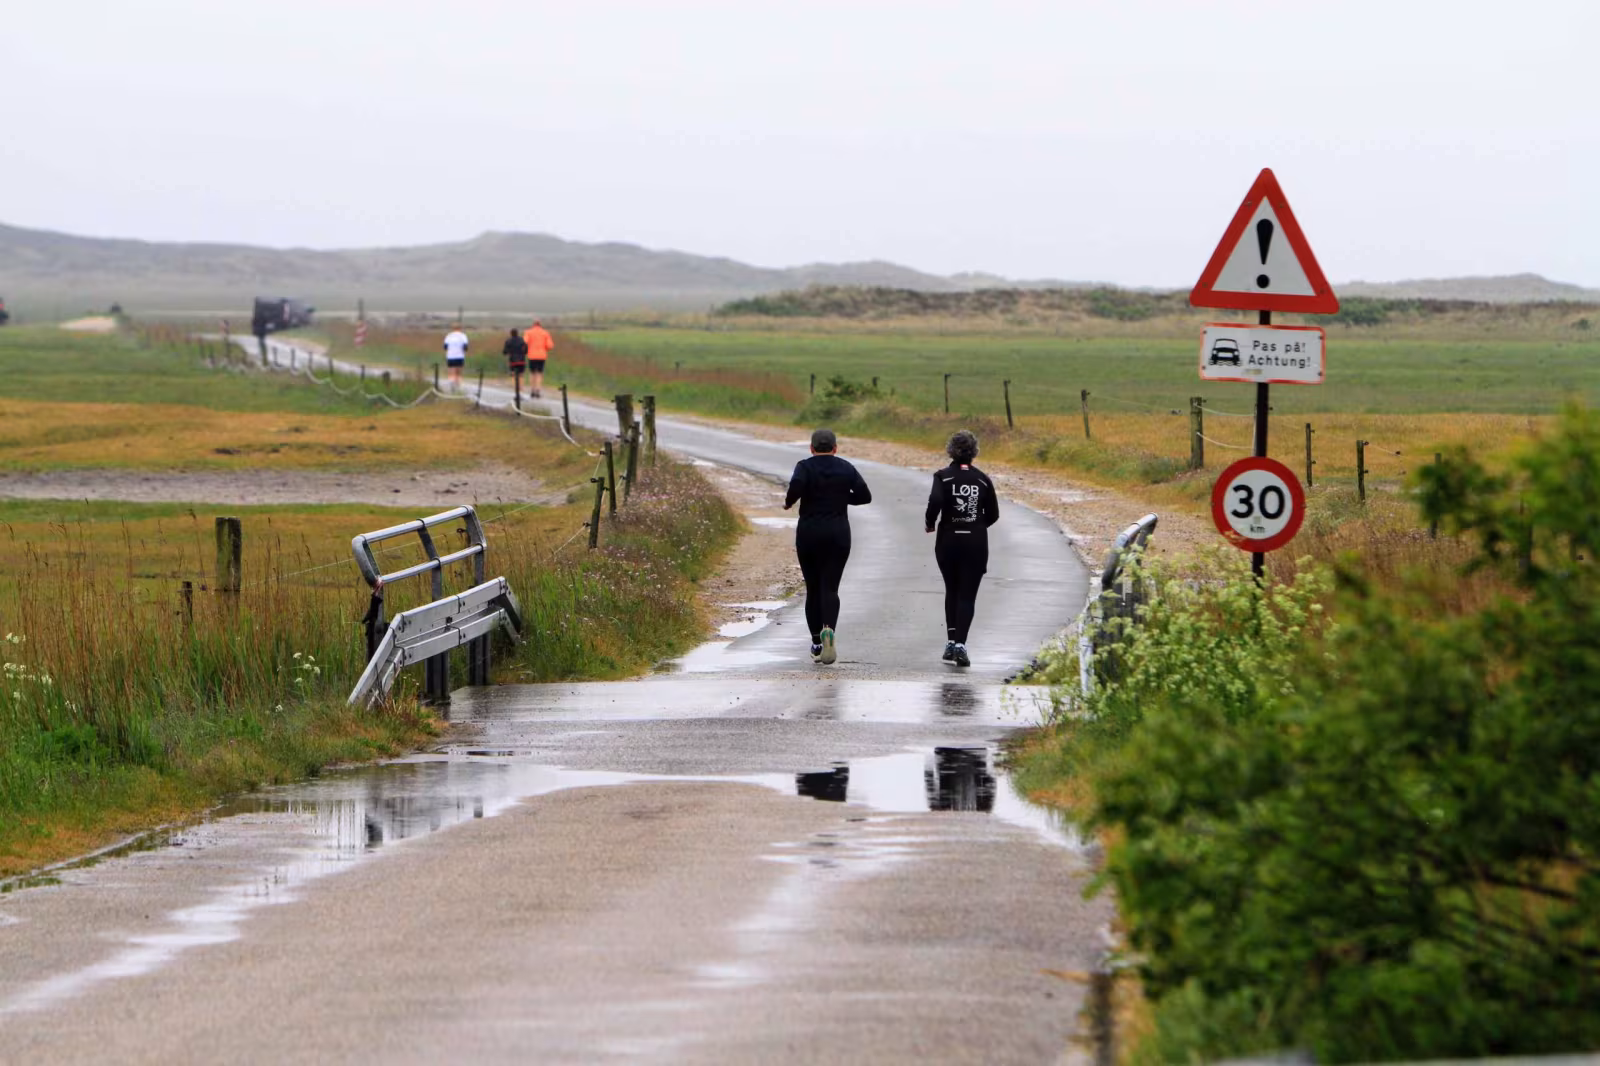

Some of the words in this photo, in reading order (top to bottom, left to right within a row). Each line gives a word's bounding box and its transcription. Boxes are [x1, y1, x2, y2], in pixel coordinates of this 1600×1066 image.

[1252, 340, 1277, 352] Pas
[1284, 341, 1306, 353] på!
[1248, 354, 1311, 369] Achtung!
[952, 484, 979, 496] LØB
[1231, 484, 1285, 520] 30
[1250, 524, 1265, 533] km
